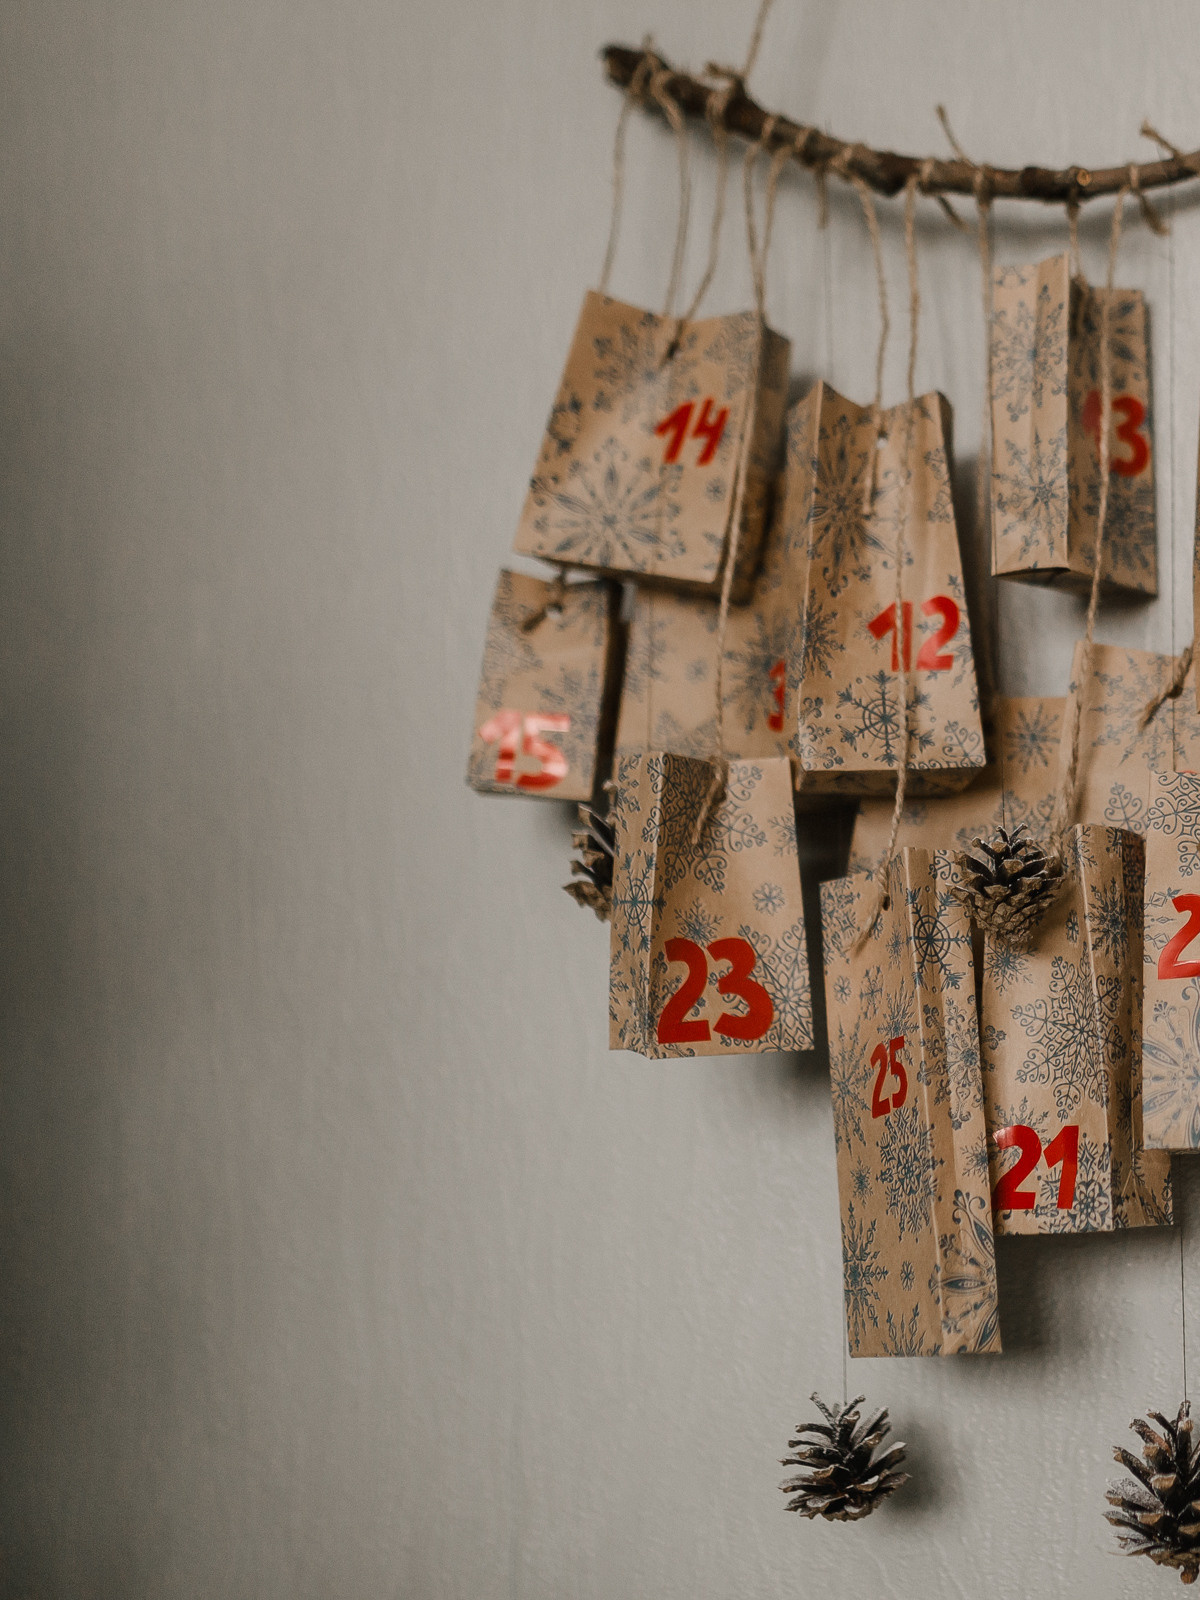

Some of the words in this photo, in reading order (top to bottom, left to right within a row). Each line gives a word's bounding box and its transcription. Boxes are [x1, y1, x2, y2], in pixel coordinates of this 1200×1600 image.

[654, 396, 731, 467] 14
[867, 595, 961, 673] 12
[479, 709, 570, 791] 15
[656, 936, 775, 1045] 23
[869, 1035, 909, 1119] 25
[993, 1124, 1080, 1211] 21
